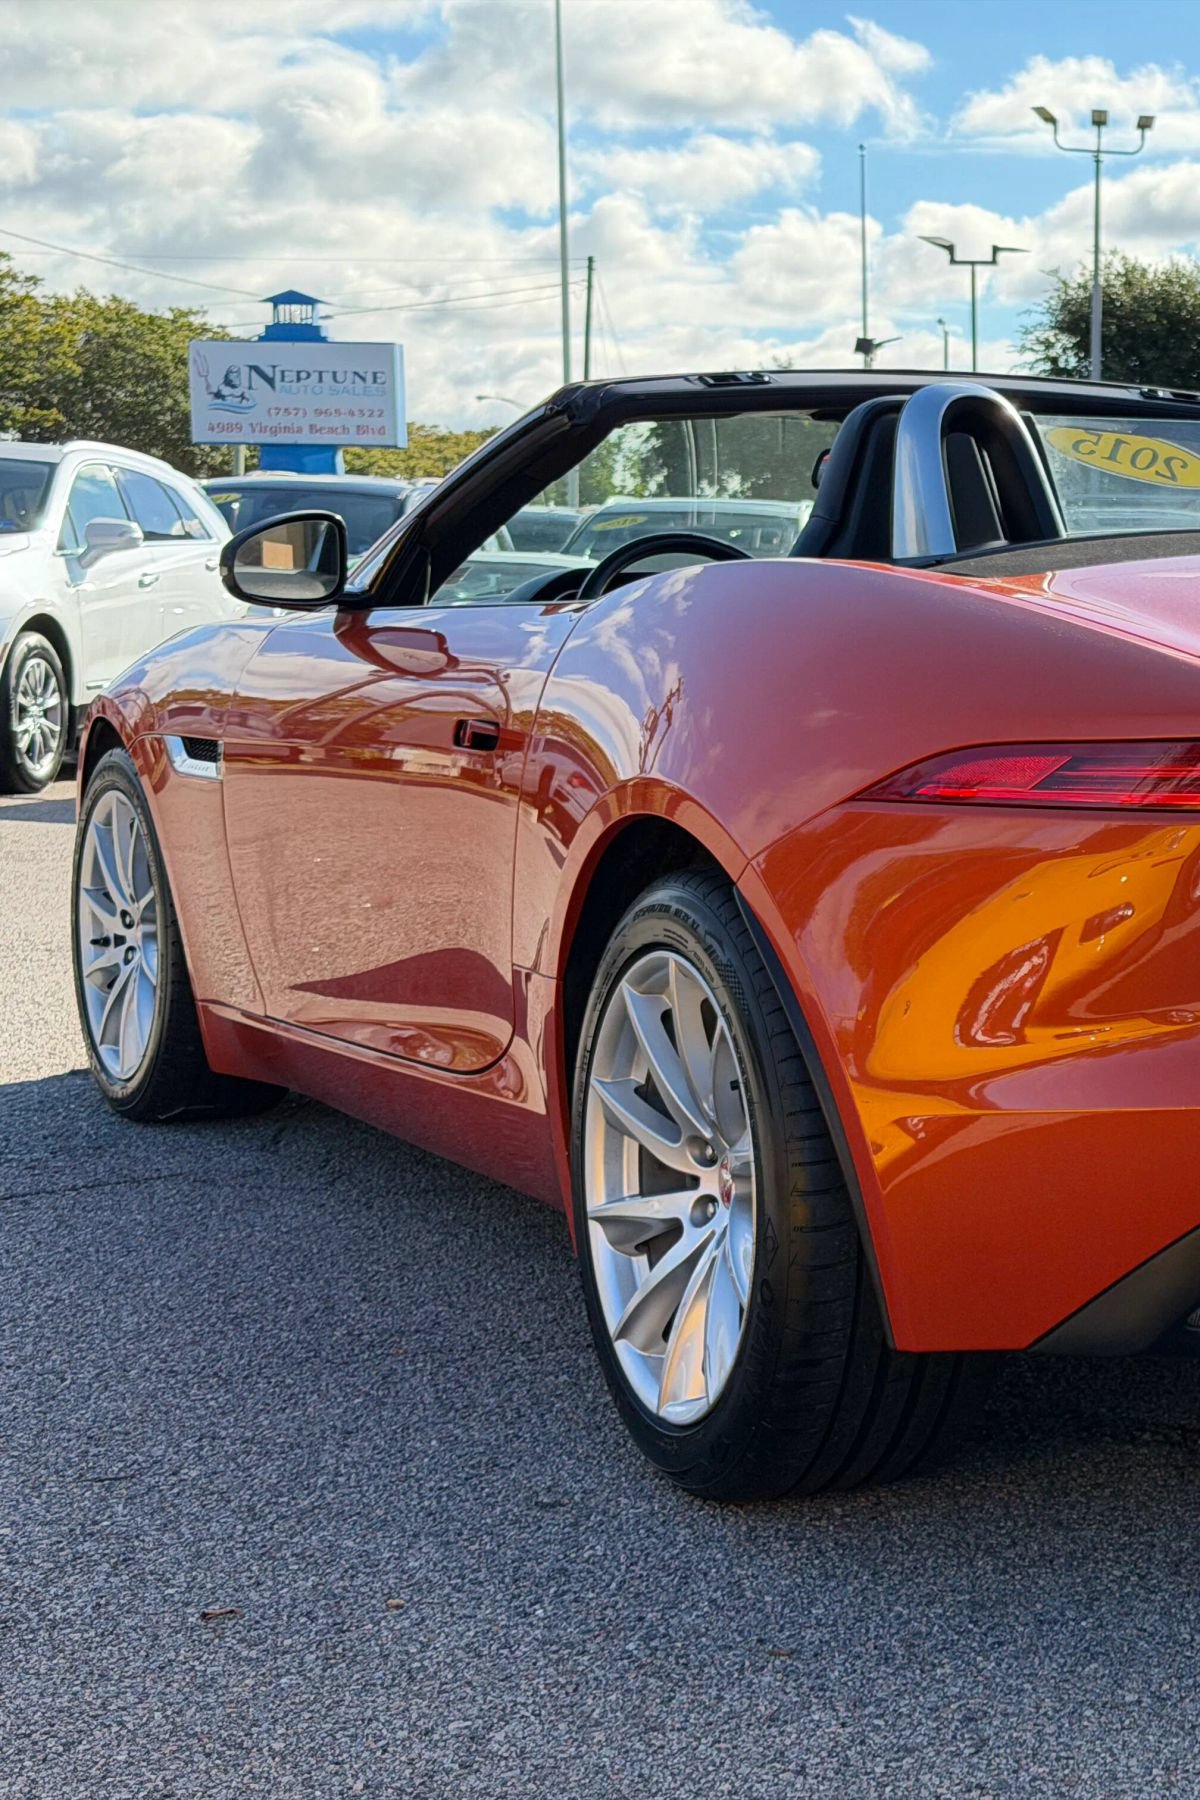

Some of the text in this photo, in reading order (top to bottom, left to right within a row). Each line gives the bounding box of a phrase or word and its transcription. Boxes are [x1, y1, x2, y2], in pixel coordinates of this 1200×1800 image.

[243, 364, 387, 392] NEPTUNE
[278, 385, 387, 397] AUTO SALES
[266, 407, 308, 418] (757)
[248, 421, 304, 437] Virginia
[309, 423, 351, 435] Beach
[356, 424, 386, 436] Blvd
